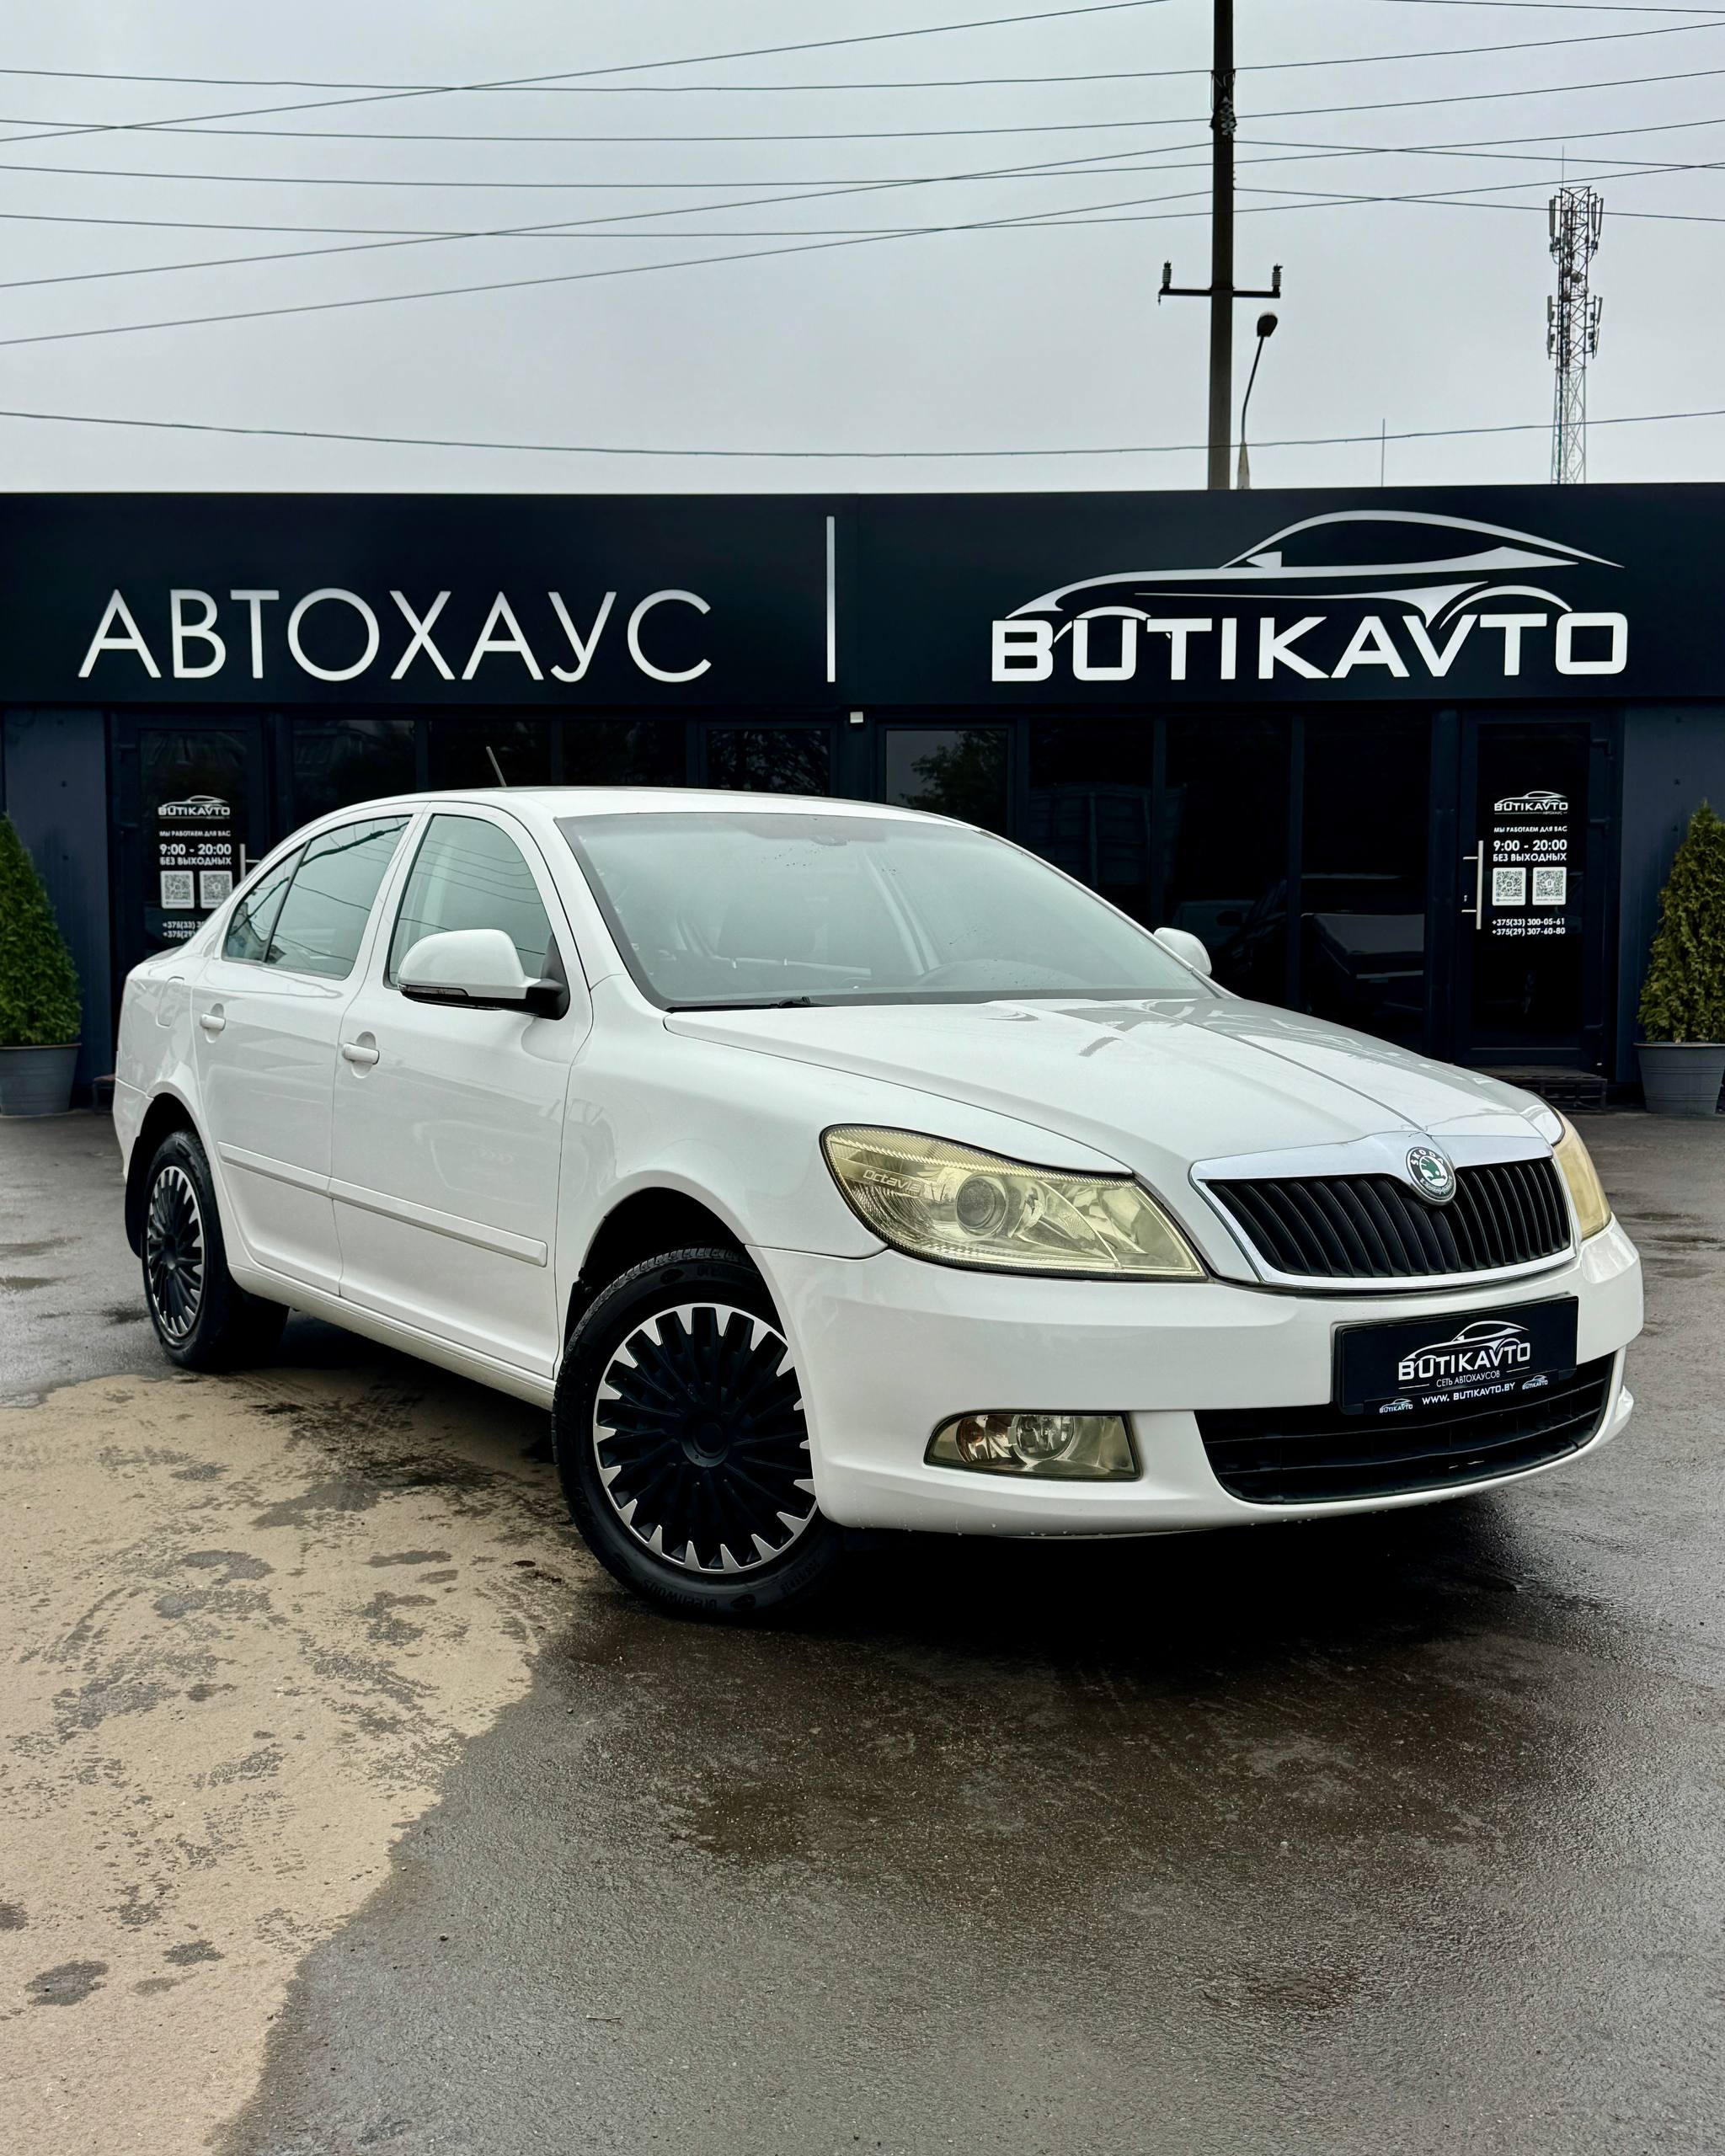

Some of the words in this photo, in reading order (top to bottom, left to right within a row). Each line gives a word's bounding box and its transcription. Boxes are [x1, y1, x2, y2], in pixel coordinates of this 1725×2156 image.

[78, 587, 713, 683] АВТОХАУС
[991, 612, 1628, 682] BUTIKAVTO
[158, 806, 231, 816] BUTIKAVTO
[1493, 802, 1568, 812] BUTIKAVTO
[1506, 825, 1539, 834] РАБОТАЕМ
[159, 843, 186, 856] 9:00
[197, 843, 232, 855] 20:00
[1493, 839, 1520, 851] 9:00
[1532, 839, 1567, 851] 20:00
[159, 857, 175, 866] БЕЗ
[177, 857, 232, 866] ВЫХОДНЫХ
[1493, 853, 1509, 862] БЕЗ
[1510, 852, 1567, 862] ВЫХОДНЫХ
[1492, 918, 1525, 927] +375(33)
[1527, 917, 1565, 926] 300-05-61
[1492, 927, 1525, 937] +375(29)
[1527, 927, 1566, 936] 307-60-80
[1398, 1342, 1530, 1381] BUTIKAVTO
[1435, 1377, 1453, 1388] СЕТЬ
[1454, 1369, 1501, 1385] АВТОХАУСОВ
[1422, 1393, 1450, 1406] WWW.
[1453, 1382, 1516, 1401] BUTIKAVTO.BY
[1379, 1404, 1413, 1414] BUTIKAVTO
